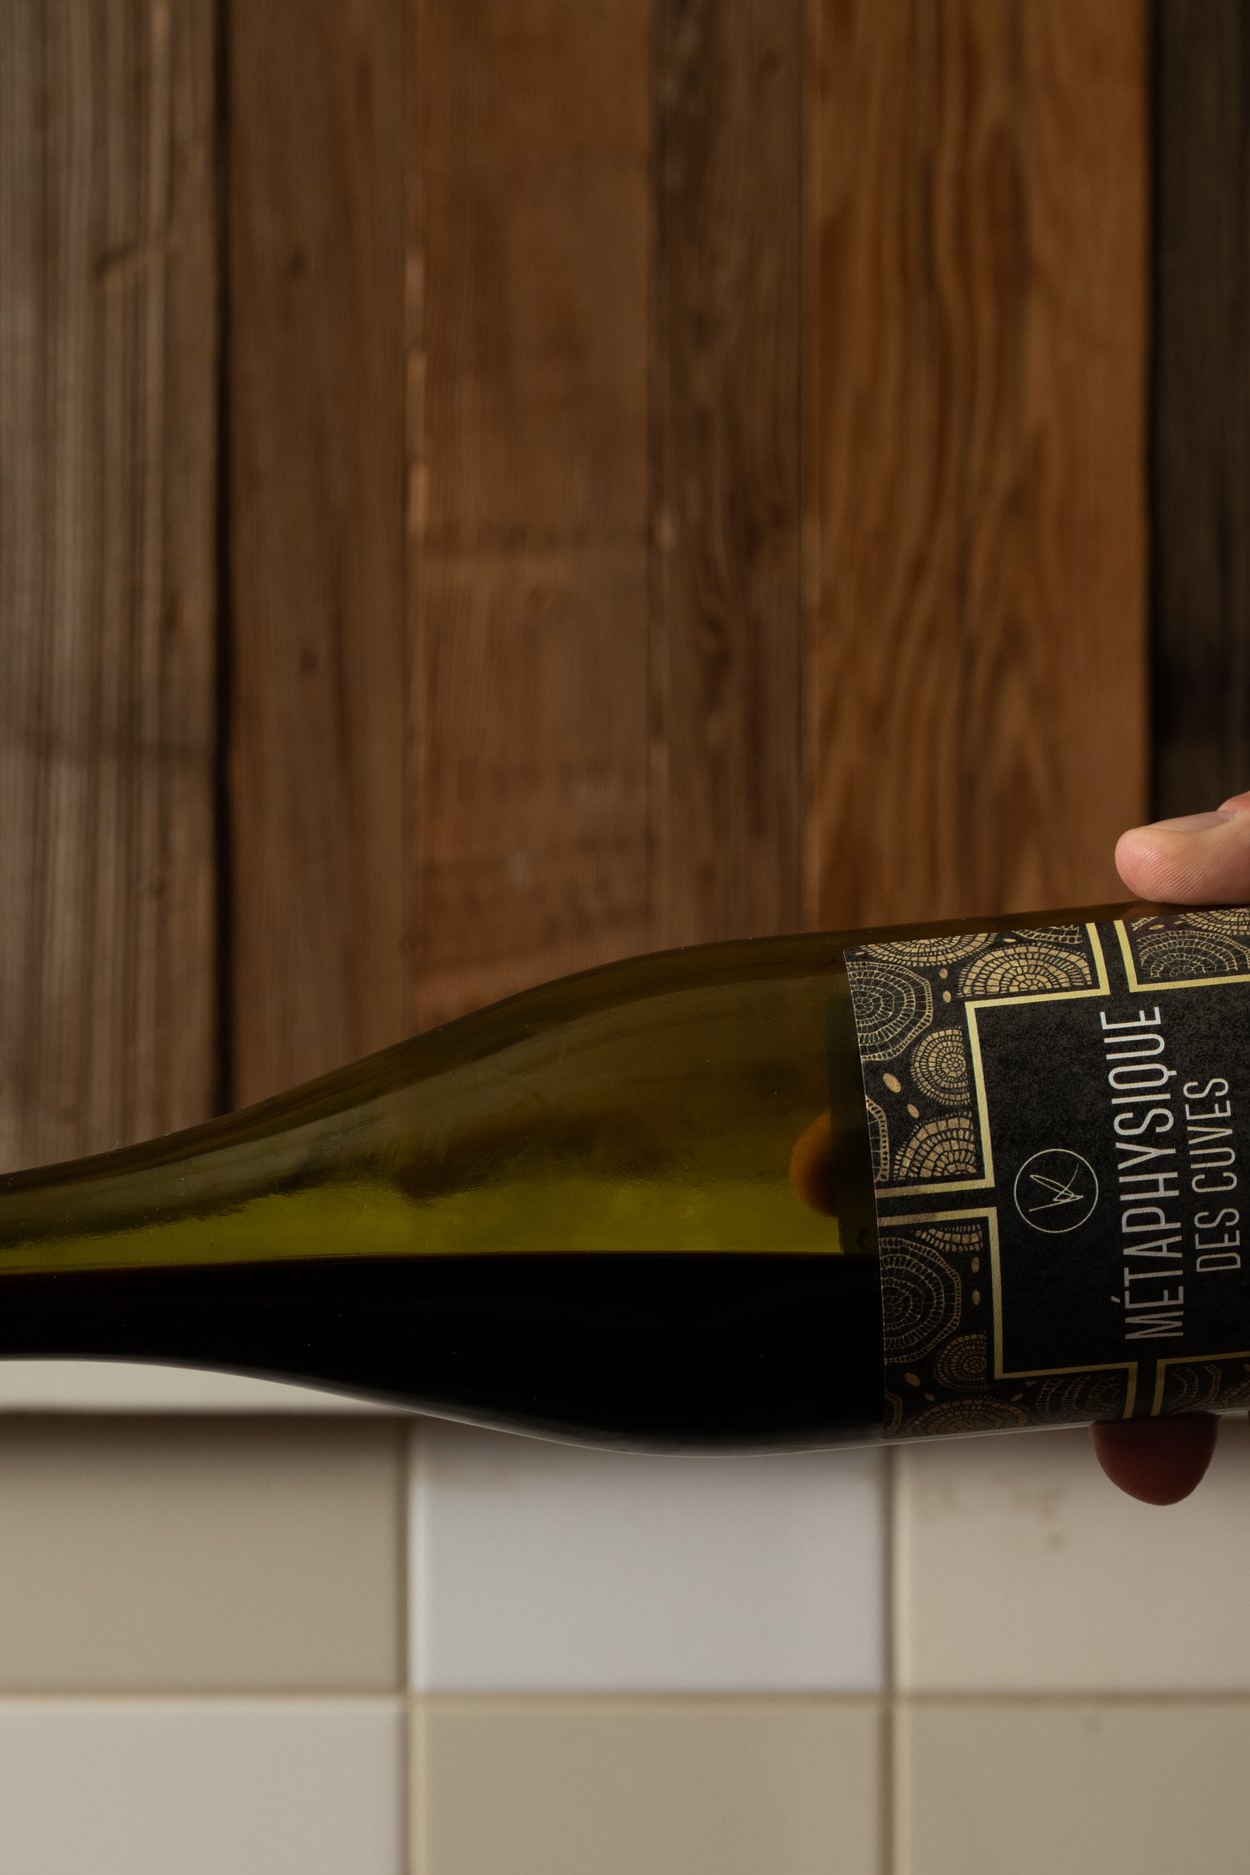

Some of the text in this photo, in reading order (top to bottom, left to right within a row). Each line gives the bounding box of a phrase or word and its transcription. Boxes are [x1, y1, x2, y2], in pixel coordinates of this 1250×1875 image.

[1099, 1005, 1185, 1341] MÉTAPHYSIQUE
[1183, 1077, 1242, 1273] DES CUVES
